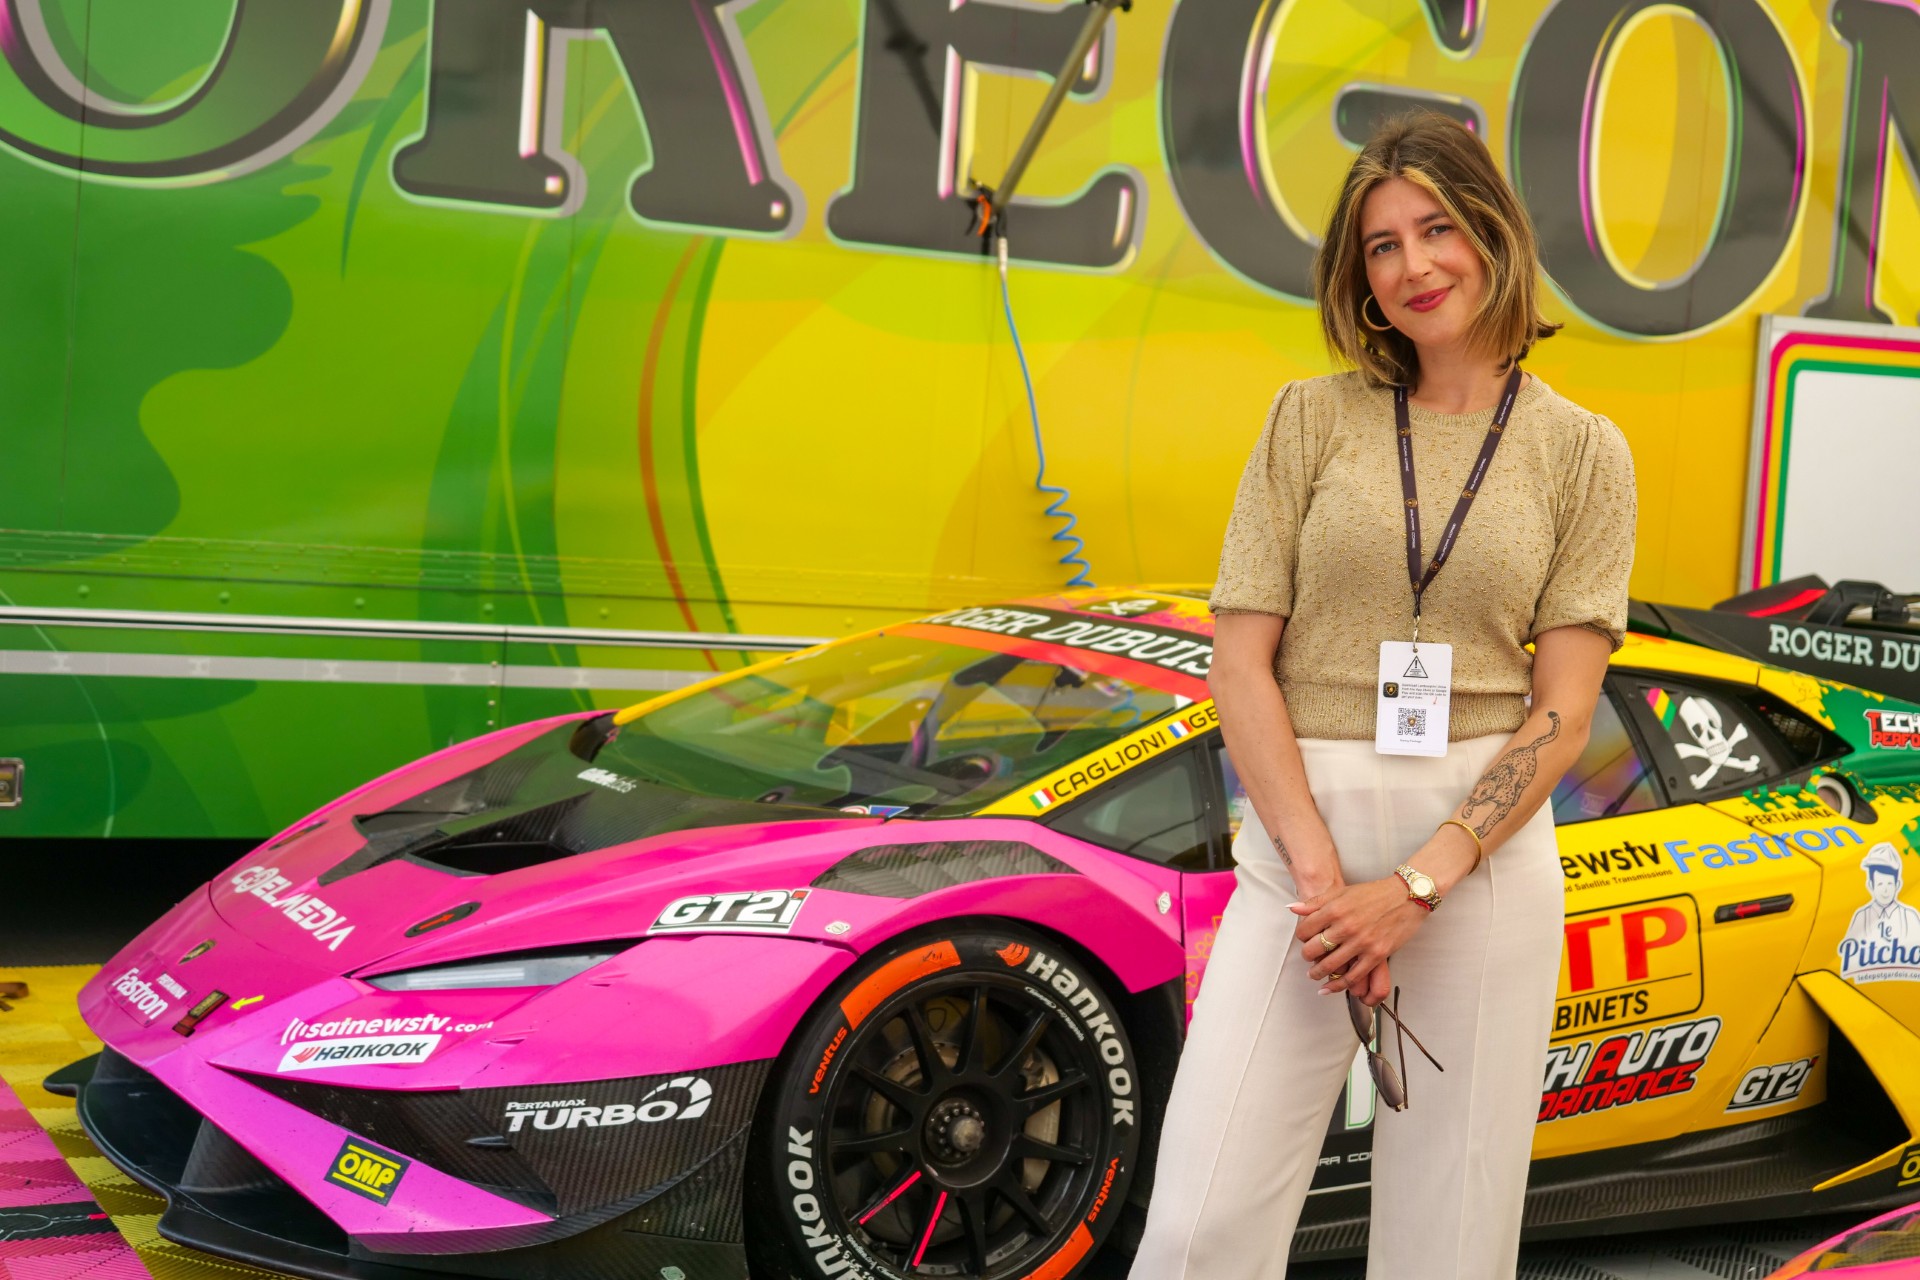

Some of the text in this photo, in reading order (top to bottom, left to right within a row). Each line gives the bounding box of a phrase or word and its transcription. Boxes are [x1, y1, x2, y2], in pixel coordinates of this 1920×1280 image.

[1030, 621, 1213, 675] DUBUIS
[1768, 624, 1874, 667] ROGER
[1052, 731, 1167, 798] CAGLIONI
[1663, 826, 1865, 874] Fastron
[1574, 878, 1612, 892] Satellite
[1612, 868, 1674, 884] Transmissions
[111, 967, 168, 1020] Fastron
[1553, 989, 1650, 1032] BINETS
[304, 1014, 495, 1039] satnewstv.com
[1584, 1017, 1720, 1083] AUTO
[504, 1100, 679, 1133] TURBO
[337, 1152, 397, 1188] OMP
